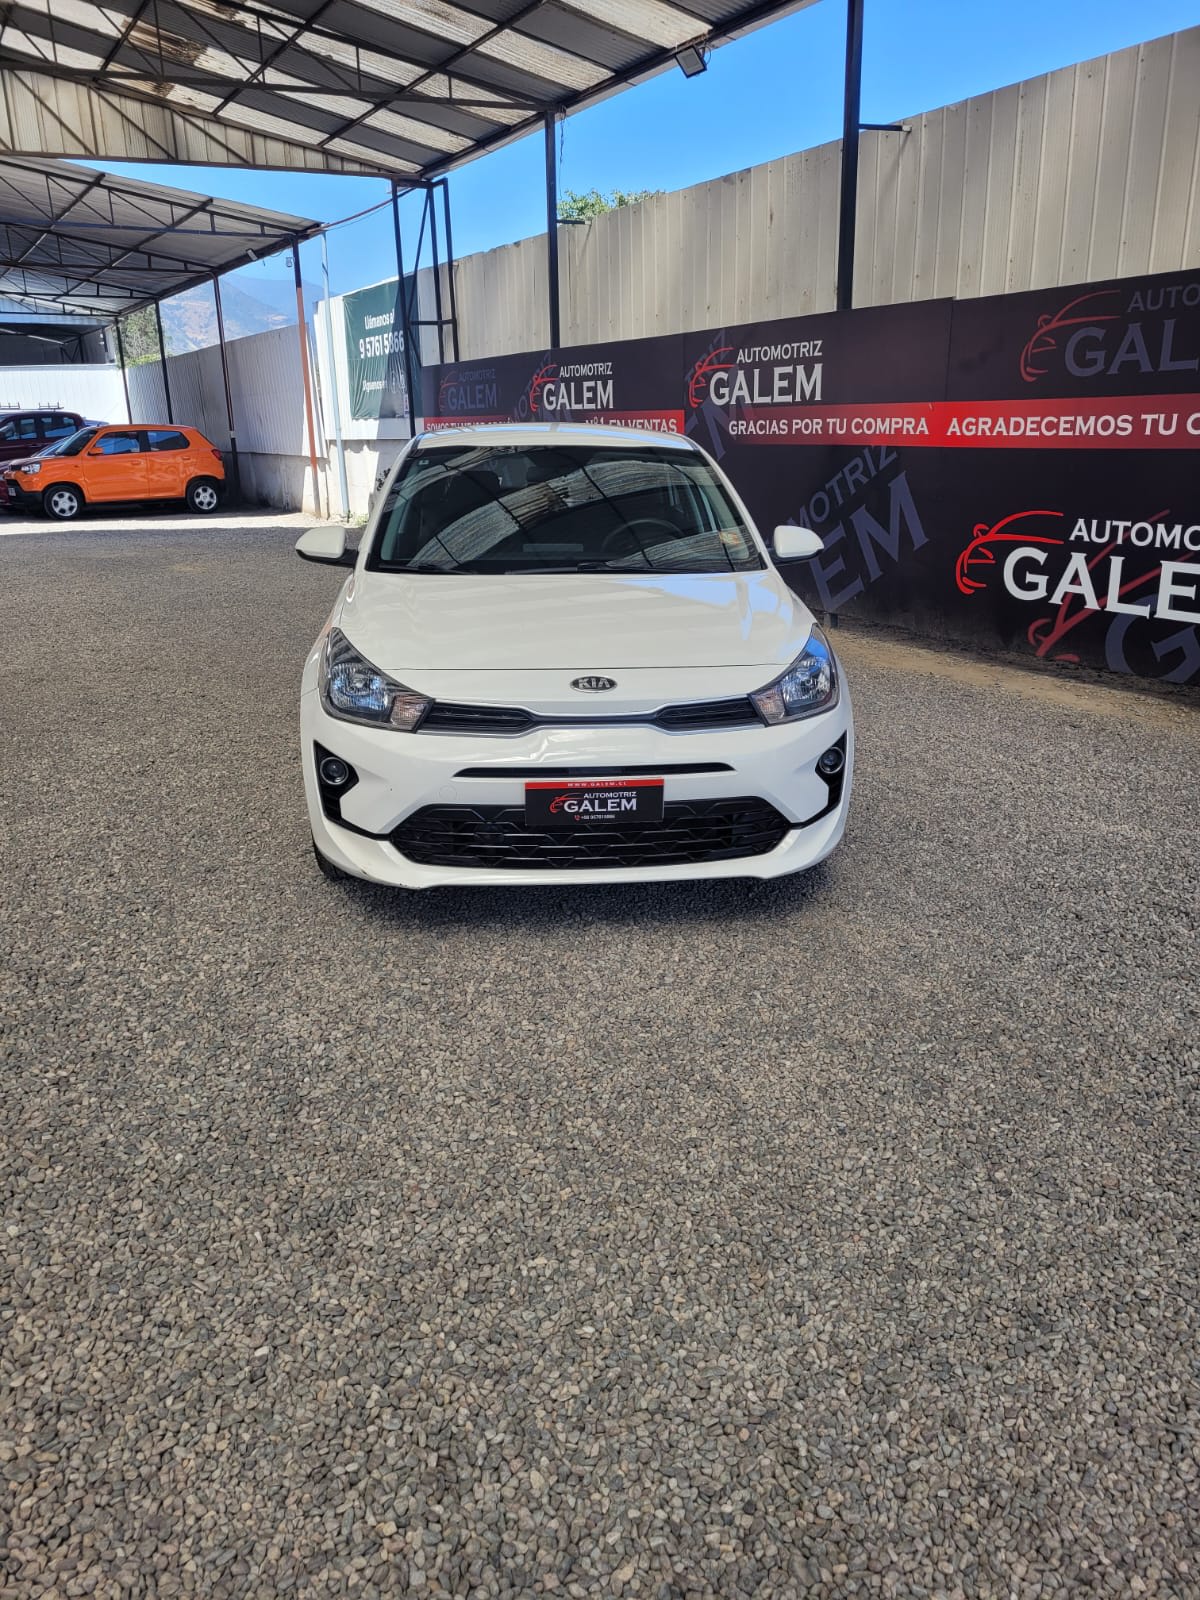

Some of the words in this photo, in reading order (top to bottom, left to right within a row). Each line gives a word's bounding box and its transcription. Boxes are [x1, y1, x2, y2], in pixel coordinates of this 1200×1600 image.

[359, 338, 365, 359] 9
[365, 334, 383, 358] 5761
[383, 330, 405, 354] 5866
[736, 340, 823, 365] AUTOMOTRIZ
[559, 362, 613, 378] AUTOMOTRIZ
[543, 379, 614, 410] GALEM
[709, 363, 823, 406] GALEM
[447, 383, 498, 410] GALEM
[627, 418, 677, 433] VENTAS
[728, 419, 788, 436] GRACIAS
[791, 418, 823, 435] POR
[826, 417, 848, 435] TU
[850, 416, 930, 436] COMPRA
[946, 414, 1134, 437] AGRADECEMOS
[1141, 413, 1179, 436] TU
[579, 677, 611, 690] KIA
[563, 798, 637, 813] GALEM
[583, 791, 637, 799] AUTOMOTRIZ
